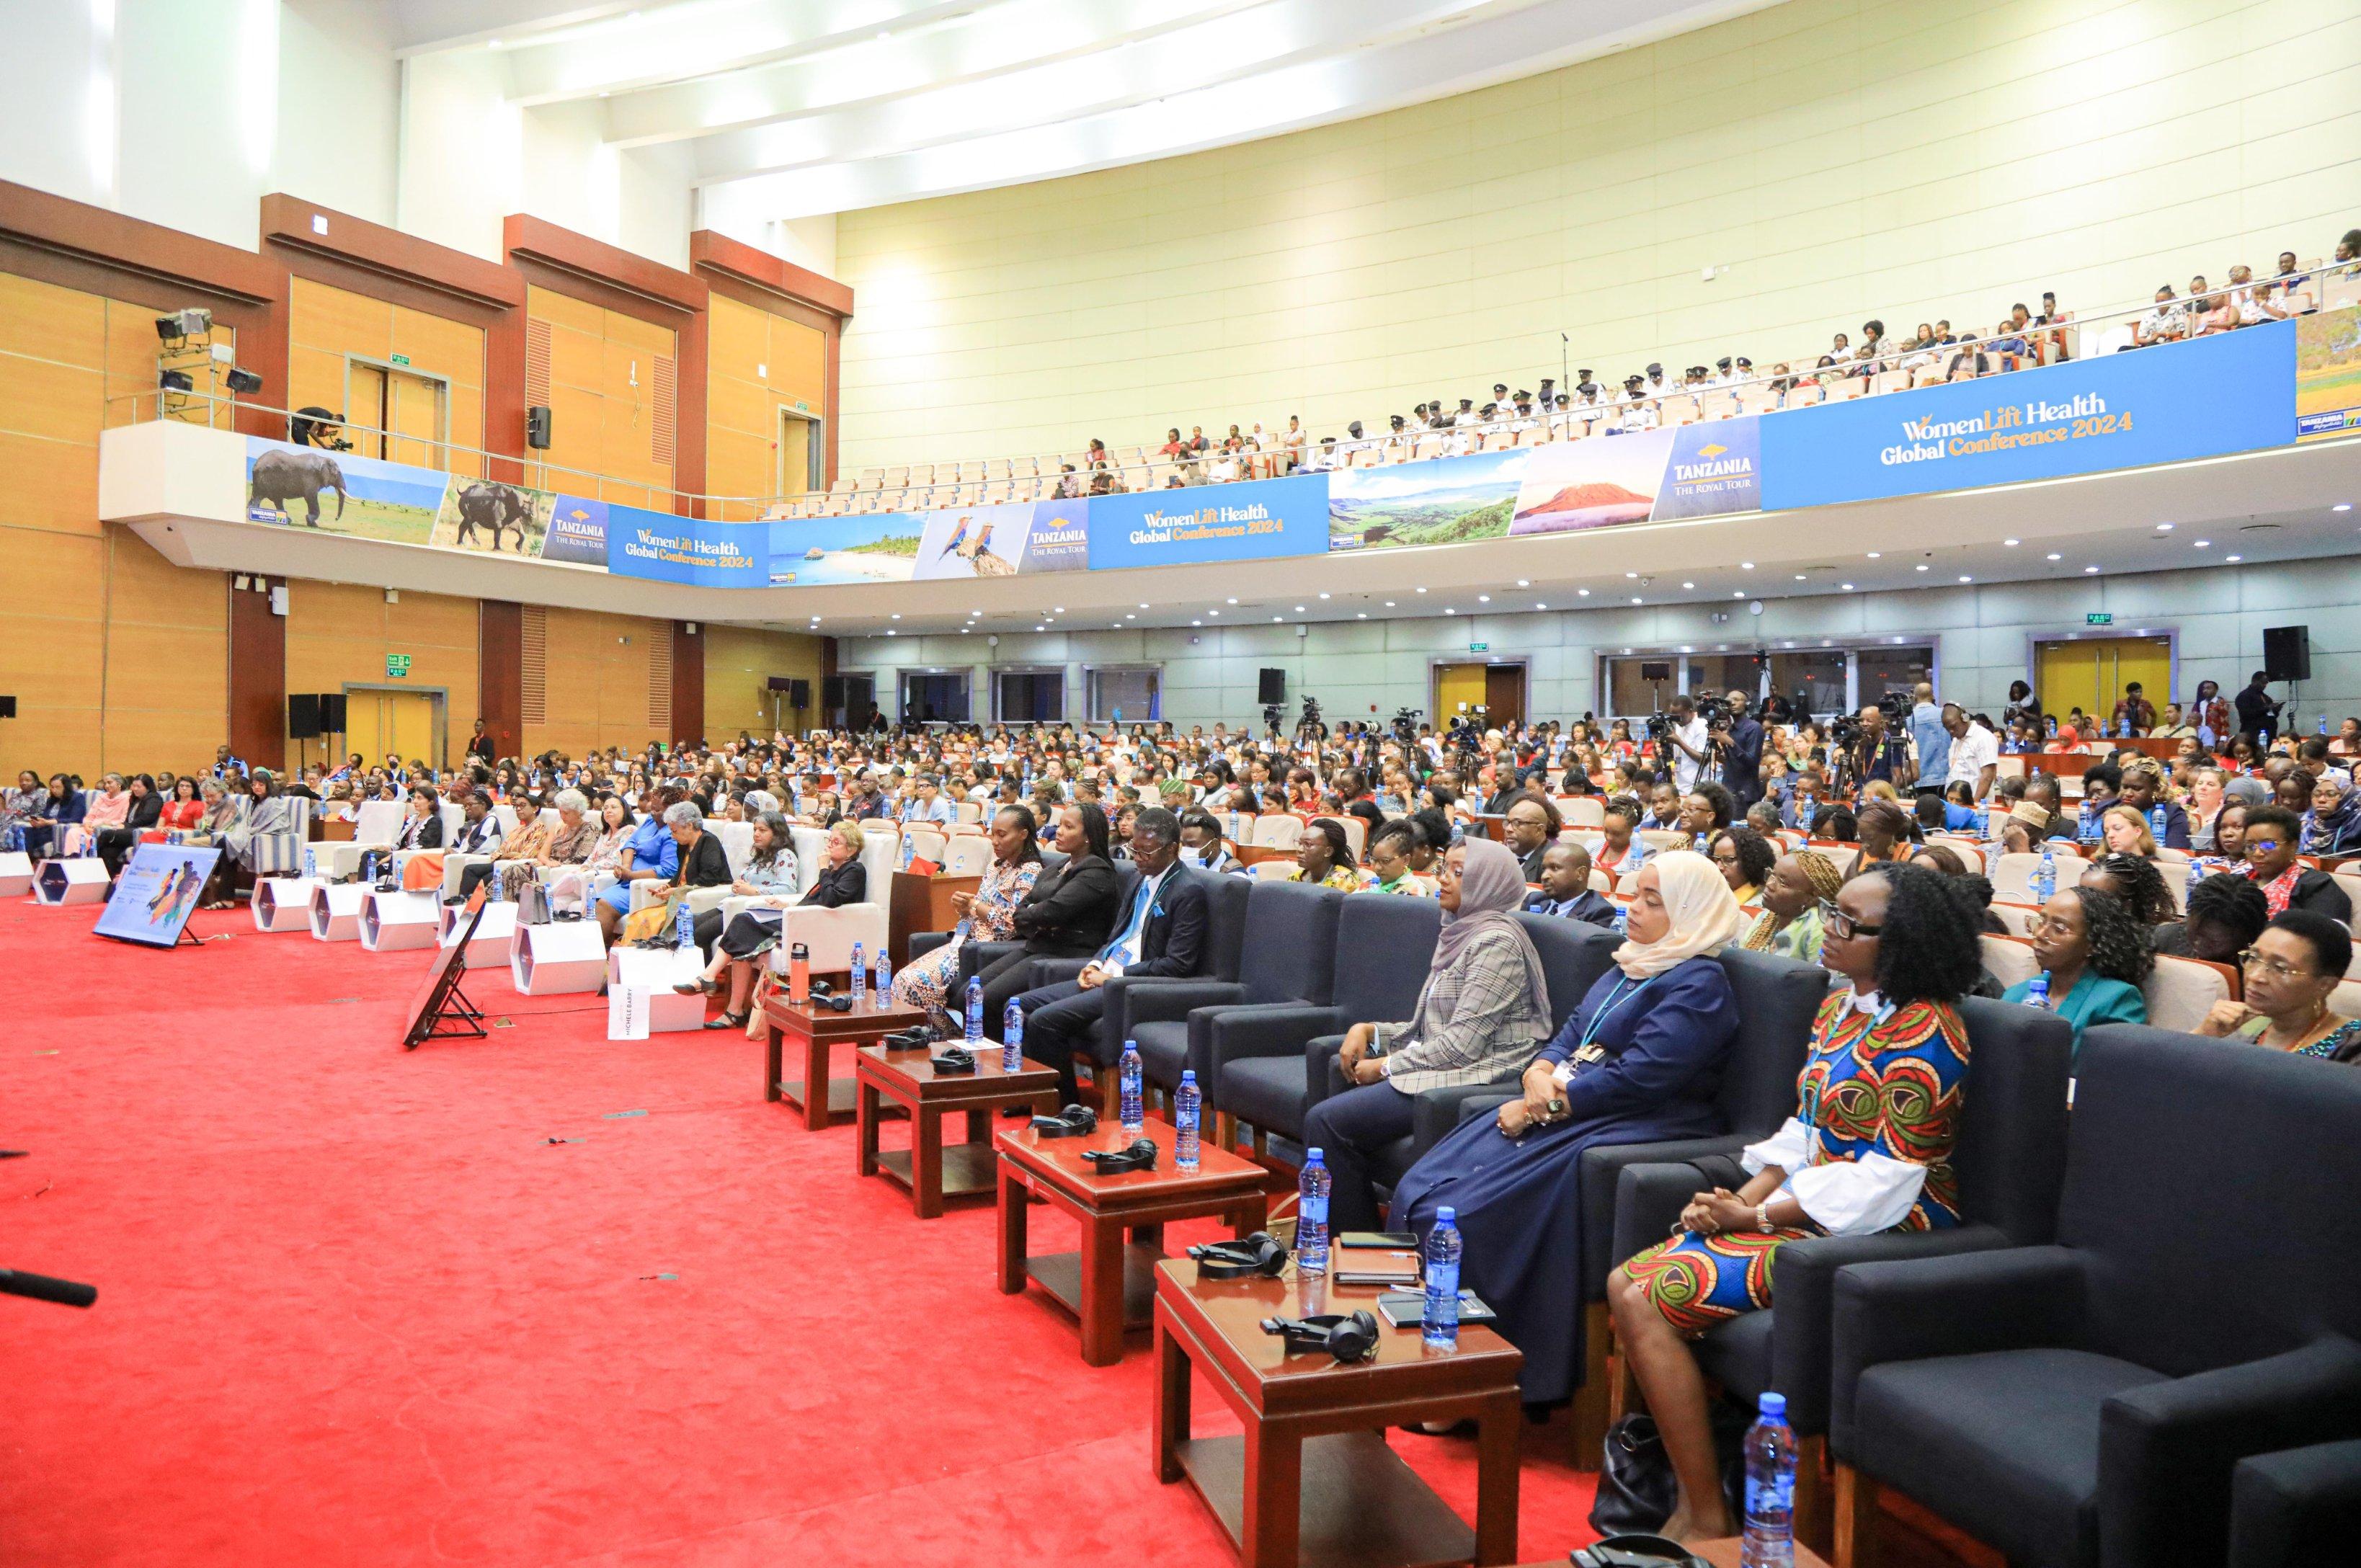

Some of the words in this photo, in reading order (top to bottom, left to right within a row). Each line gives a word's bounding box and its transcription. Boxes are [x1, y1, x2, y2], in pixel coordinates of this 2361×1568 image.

[1902, 406, 2022, 442] WomenLift
[2027, 392, 2106, 424] Health
[1880, 440, 1945, 466] Global
[1948, 427, 2068, 456] Conference
[2071, 411, 2133, 438] 2024
[1674, 458, 1752, 481] TANZANIA
[1674, 486, 1694, 496] THE
[1696, 483, 1724, 494] ROYAL
[1725, 479, 1751, 490] TOUR
[556, 519, 604, 538] TANZANIA
[1144, 509, 1218, 529] WomenLift
[1220, 504, 1268, 522] Health
[569, 538, 588, 548] ROYAL
[589, 540, 604, 549] TOUR
[636, 528, 692, 551] WomenLift
[694, 540, 739, 556] Health
[1032, 530, 1086, 545] TANZANIA
[1130, 528, 1170, 545] Global
[1173, 524, 1245, 540] Conference
[1248, 519, 1284, 535] 2024
[625, 543, 657, 559] Global
[658, 549, 716, 566] Conference
[719, 556, 754, 568] 2024
[1068, 545, 1086, 554] TOUR
